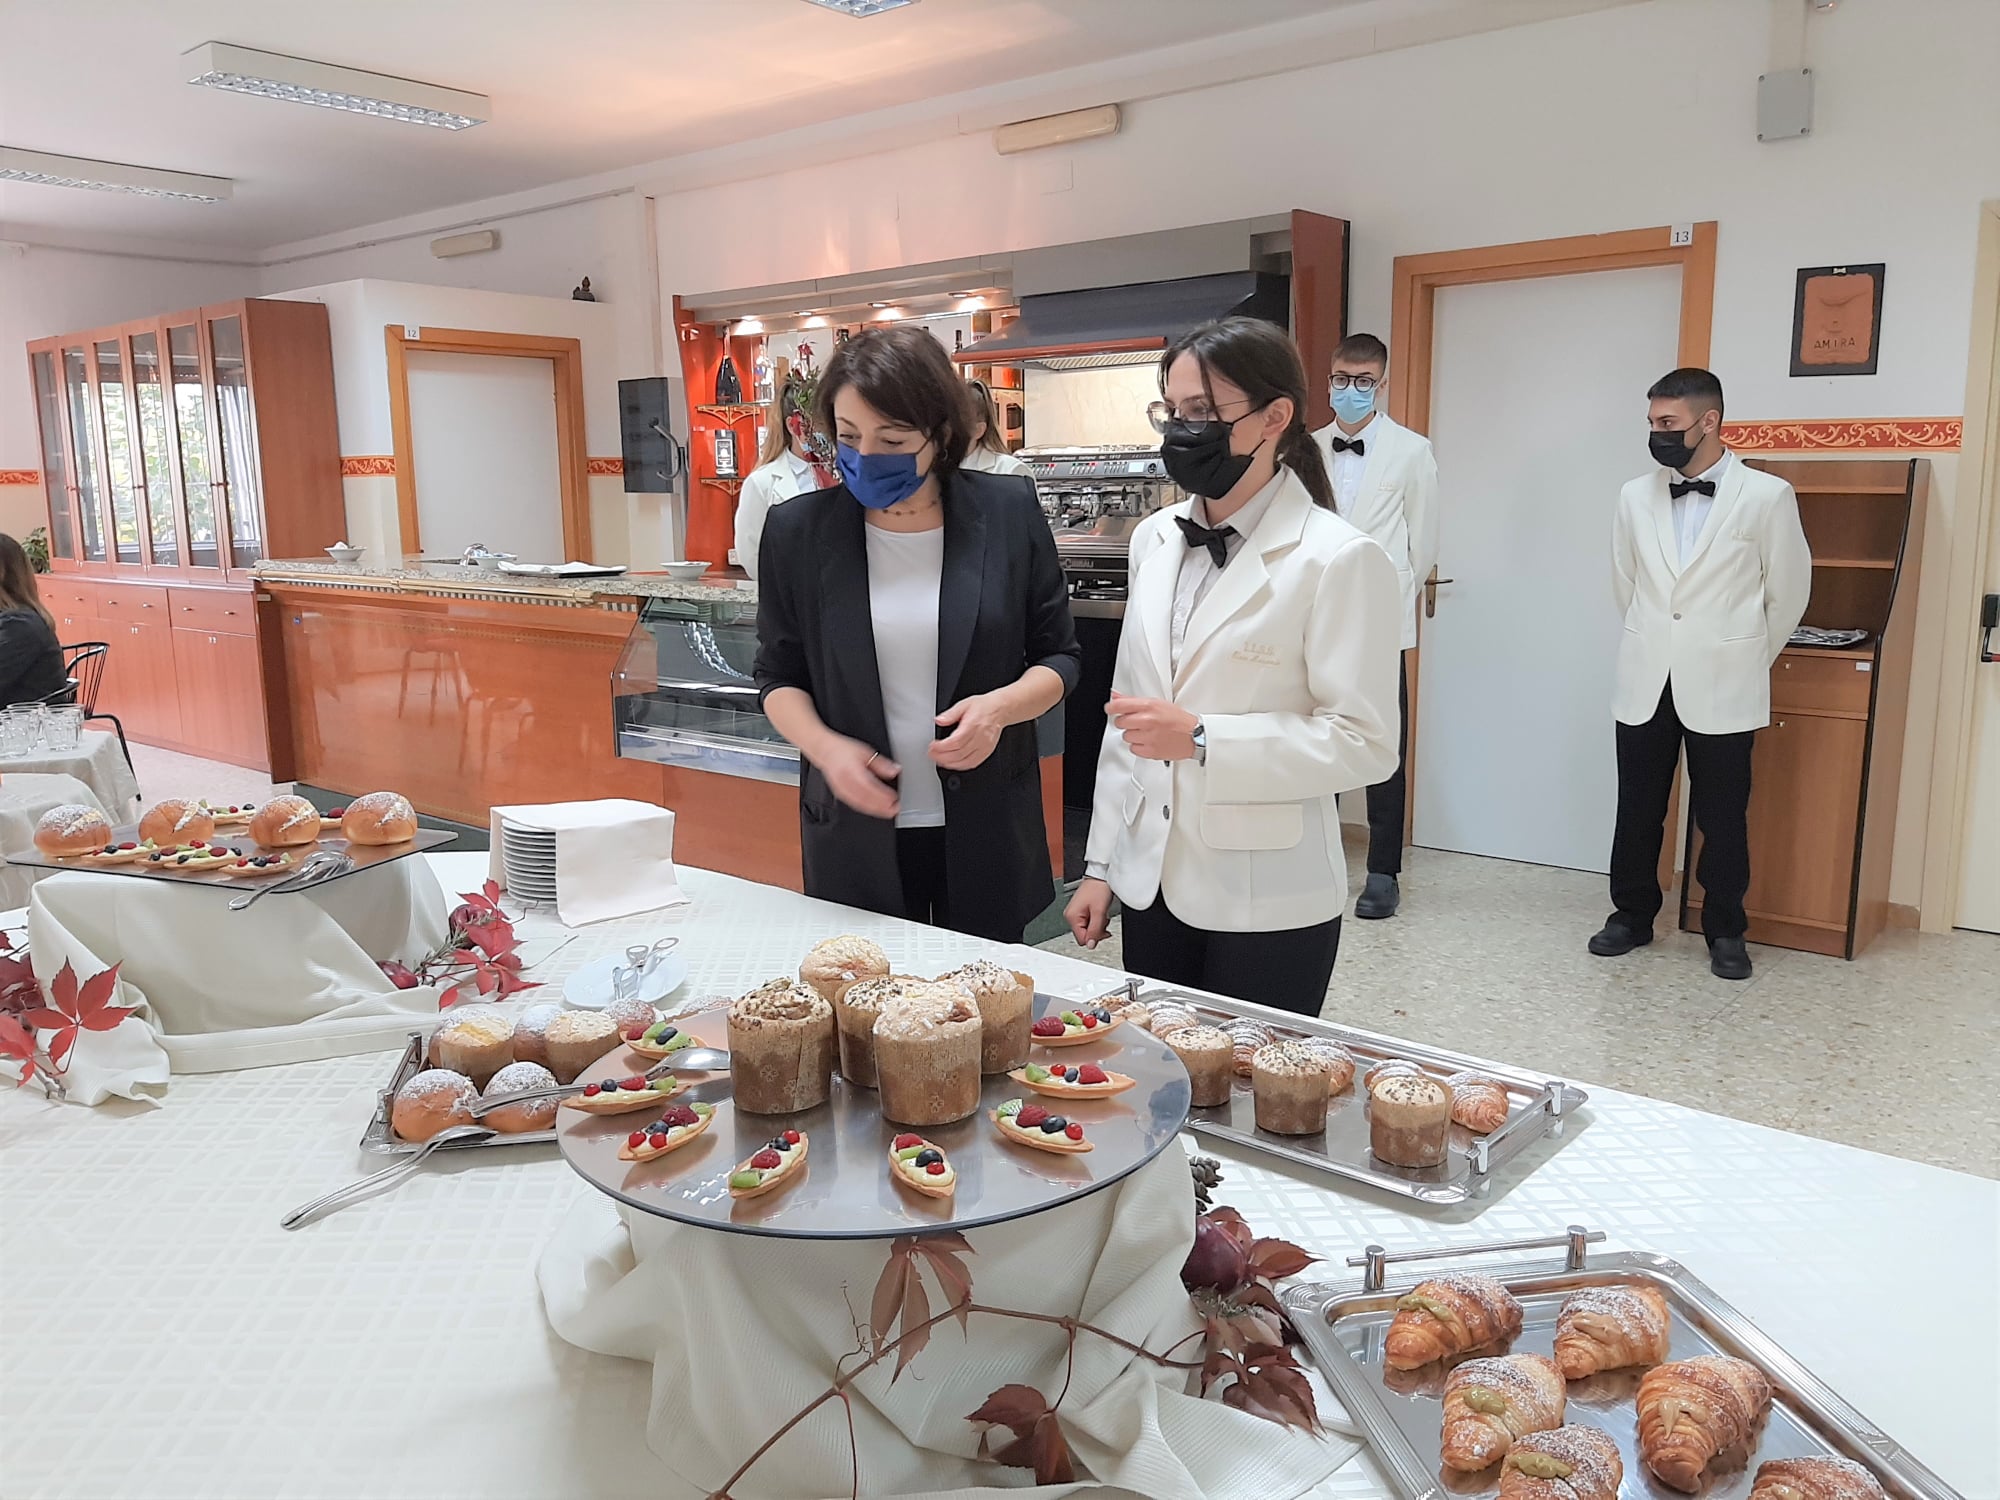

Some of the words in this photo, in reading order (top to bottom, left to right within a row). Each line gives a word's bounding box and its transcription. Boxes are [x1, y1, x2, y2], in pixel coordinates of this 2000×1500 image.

[1673, 231, 1689, 243] 13
[407, 329, 417, 338] 12
[1813, 336, 1857, 350] AMIRA
